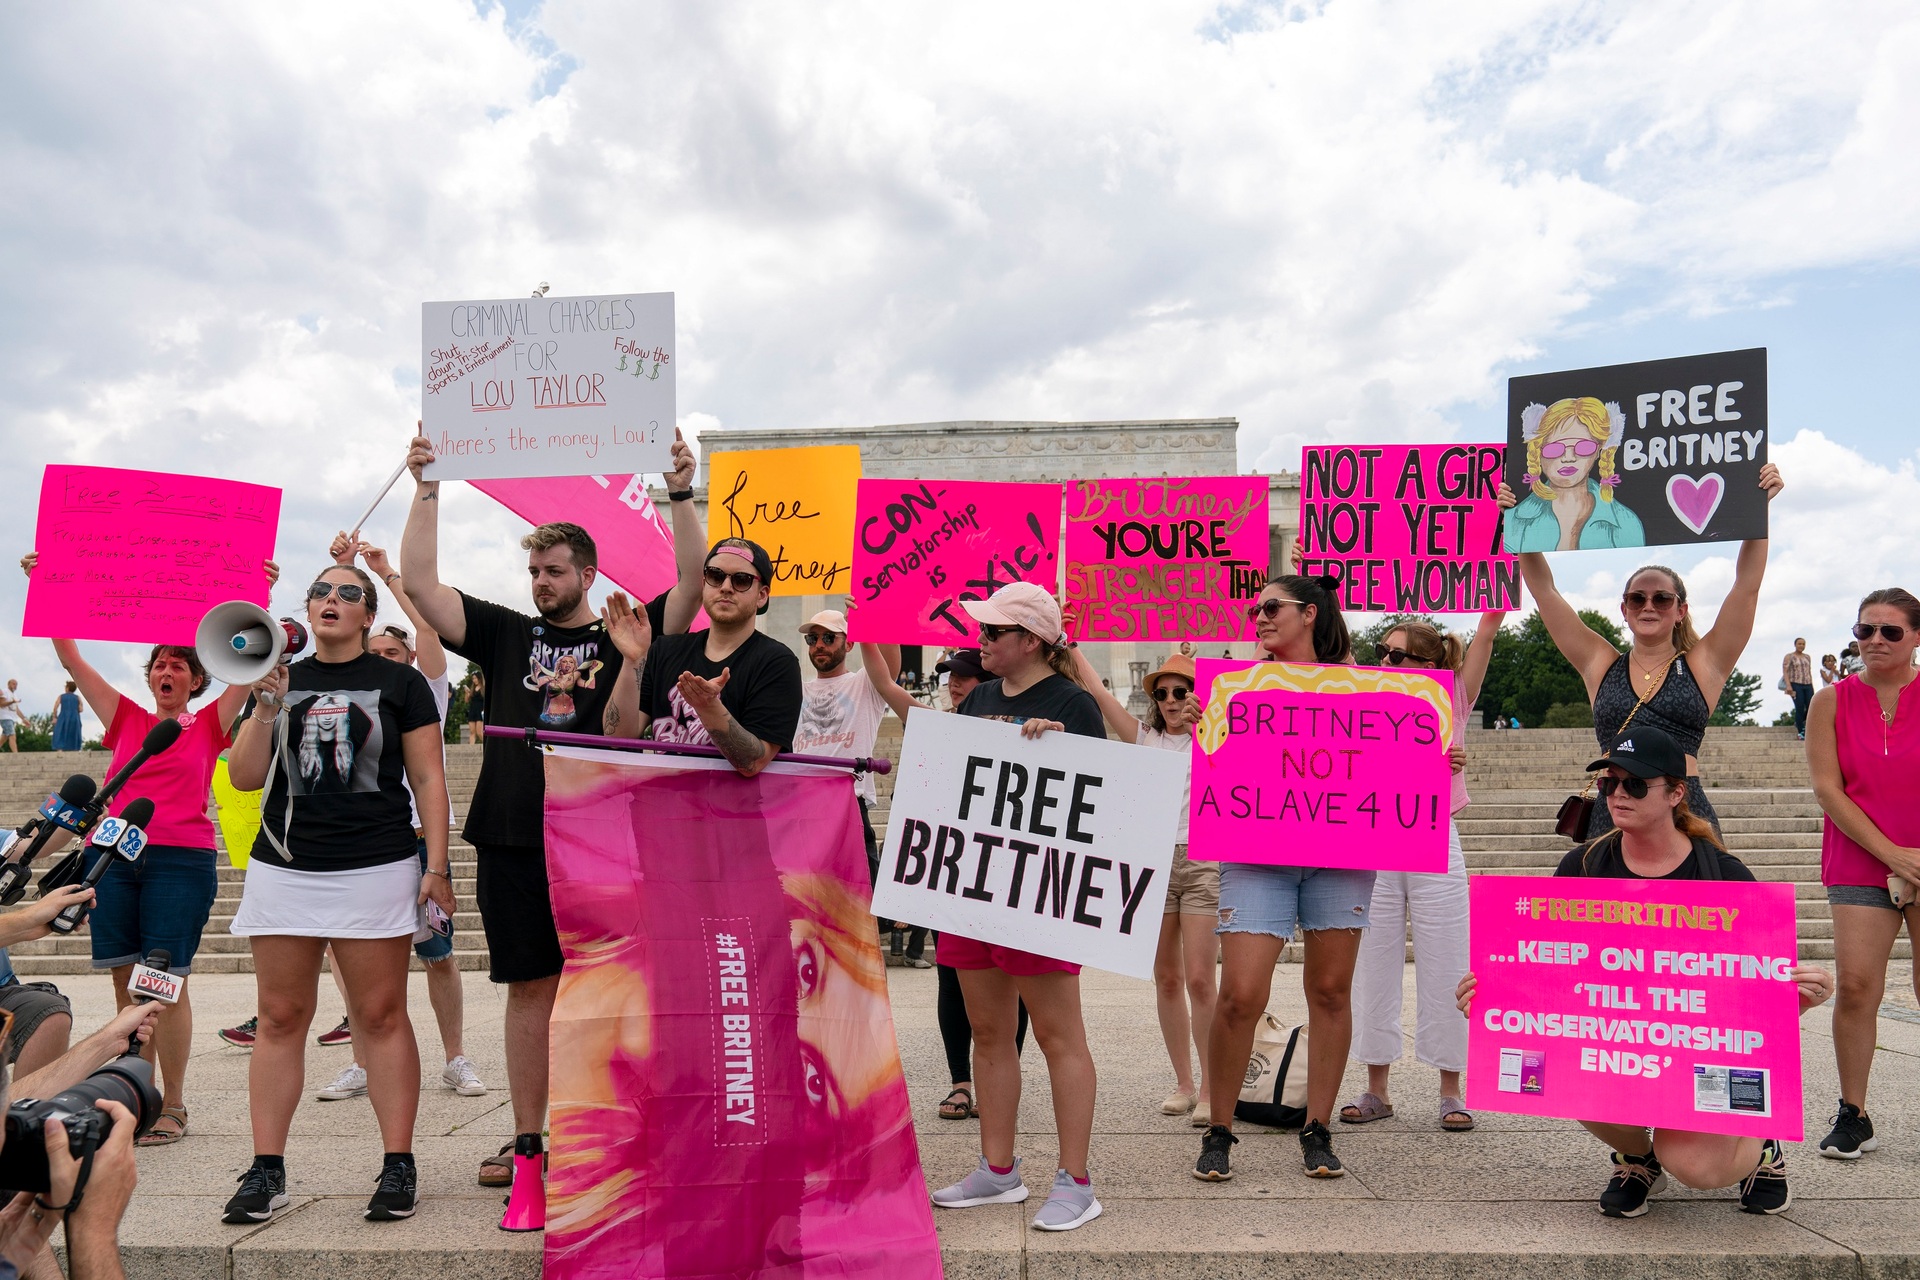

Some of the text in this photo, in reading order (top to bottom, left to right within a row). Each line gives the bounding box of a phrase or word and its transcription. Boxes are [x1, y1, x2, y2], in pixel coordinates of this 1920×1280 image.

[451, 299, 635, 338] CRIMINAL CHARGES
[459, 369, 465, 377] &
[464, 335, 515, 373] Entertainment
[513, 341, 559, 371] FOR
[614, 336, 670, 365] Follow the
[428, 361, 456, 381] down
[470, 373, 606, 407] LOU TAYLOR
[1636, 381, 1744, 429] FREE
[508, 427, 539, 451] the
[548, 431, 605, 459] money,
[1623, 429, 1764, 471] BRITNEY
[1305, 448, 1382, 499] NOT
[1394, 448, 1427, 500] A
[723, 470, 820, 538] free
[861, 483, 946, 555] CON-
[1069, 480, 1267, 536] Britney
[1092, 520, 1231, 560] YOU'RE
[1304, 502, 1381, 554] NOT
[1401, 503, 1474, 556] YET
[926, 565, 947, 588] is
[1066, 561, 1223, 602] STRONGER
[1393, 559, 1521, 612] WOMAN
[1070, 601, 1252, 641] YESTERDAY
[794, 731, 856, 753] Britney
[1229, 702, 1436, 746] BRITNEY'S
[1282, 748, 1363, 780] NOT
[58, 809, 74, 823] 4
[958, 755, 1103, 844] FREE
[1198, 785, 1221, 817] A
[1230, 785, 1348, 825] SLAVE
[1356, 792, 1381, 829] 4
[95, 834, 114, 844] WUSA
[120, 842, 136, 858] WUSA
[893, 818, 1155, 936] BRITNEY
[1515, 896, 1739, 932] #FREEBRITNEY
[146, 970, 171, 982] LOCAL
[715, 932, 749, 1007] #FREE
[1600, 947, 1644, 972] ON
[1653, 951, 1793, 982] FIGHTING
[137, 975, 173, 996] DVM
[1648, 987, 1706, 1014] THE
[1484, 1008, 1764, 1055] CONSERVATORSHIP
[722, 1014, 755, 1126] BRITNEY
